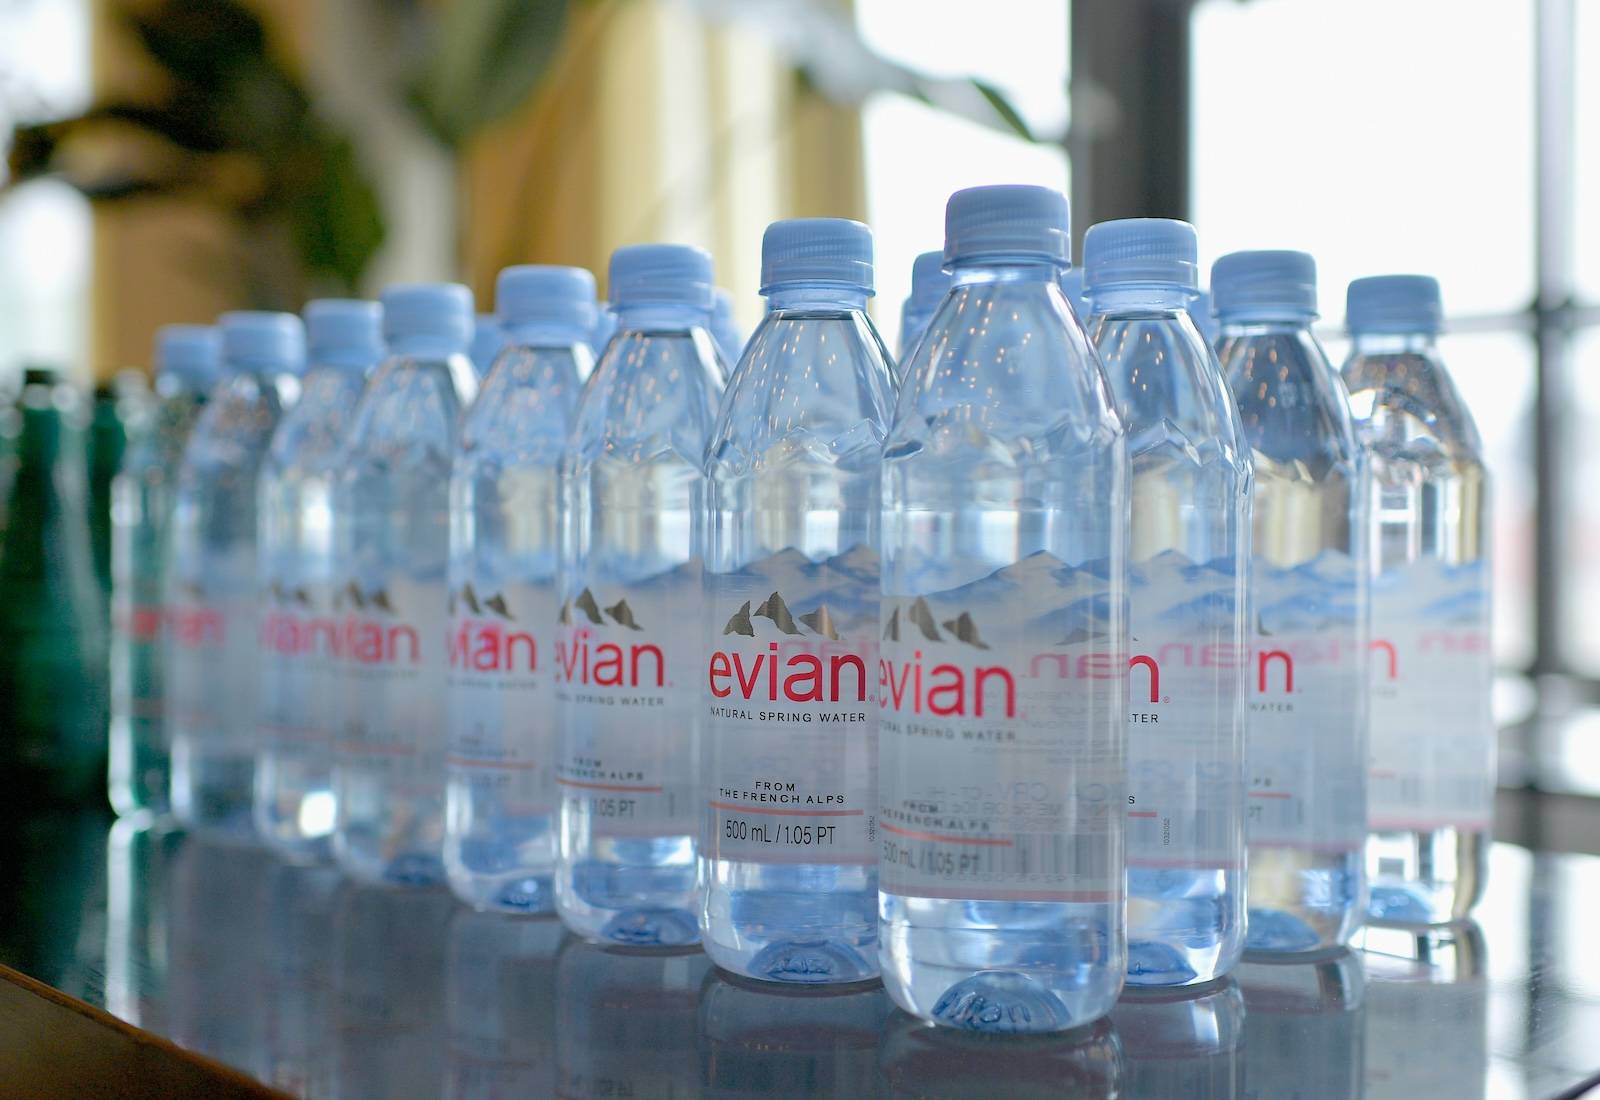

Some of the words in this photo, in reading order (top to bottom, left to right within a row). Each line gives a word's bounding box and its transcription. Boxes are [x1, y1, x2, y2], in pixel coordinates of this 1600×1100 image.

[709, 642, 866, 702] evian
[710, 706, 752, 720] NATURAL
[759, 711, 812, 722] SPRING
[820, 713, 866, 723] WATER
[1129, 713, 1159, 723] TER
[962, 728, 1016, 742] WATER
[755, 781, 795, 792] FROM
[719, 788, 738, 799] THE
[743, 792, 799, 803] FRENCH
[806, 795, 845, 804] ALPS
[726, 820, 747, 840] 500
[751, 825, 771, 843] mL
[776, 824, 781, 844] /
[785, 826, 812, 845] 1.05
[817, 827, 836, 844] PT
